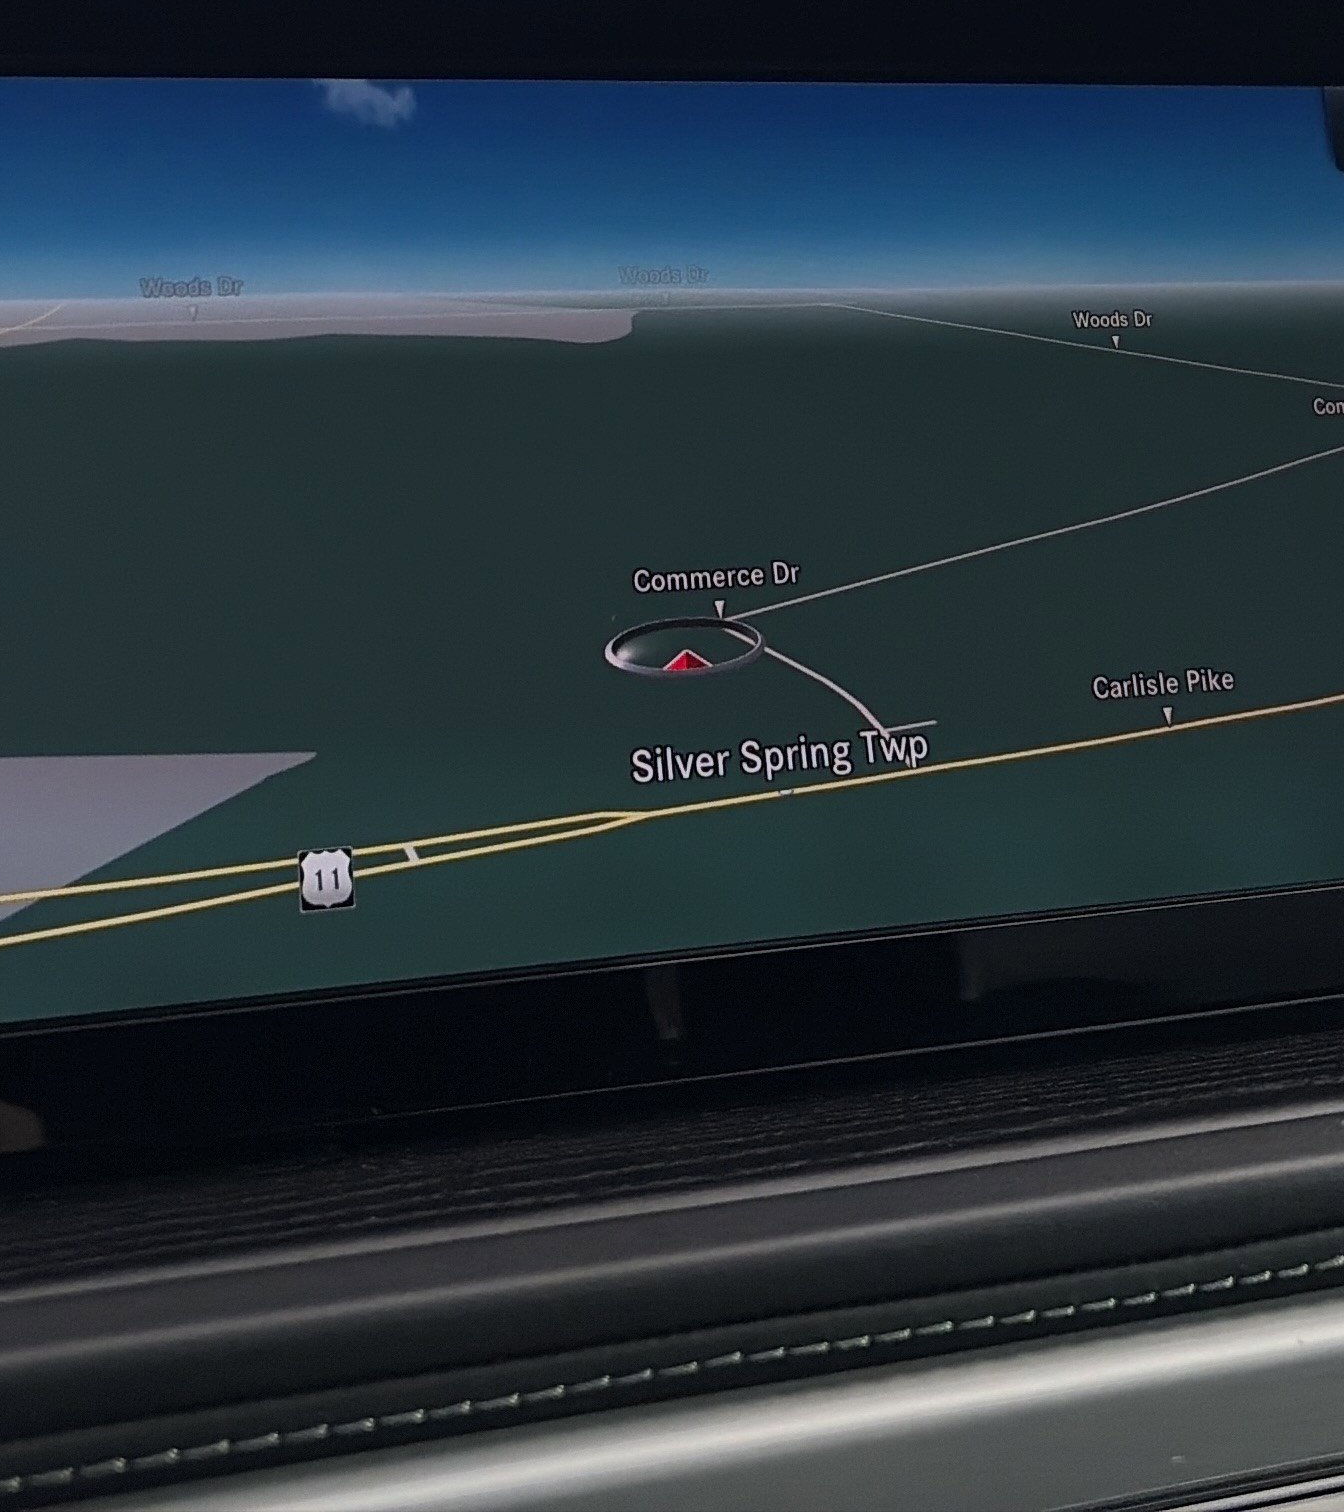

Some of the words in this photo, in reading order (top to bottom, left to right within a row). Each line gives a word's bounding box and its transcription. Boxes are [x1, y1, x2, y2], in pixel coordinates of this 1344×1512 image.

[139, 277, 212, 298] Woods
[217, 276, 244, 297] Dr
[1072, 311, 1129, 328] Woods
[1134, 310, 1152, 327] Dr
[633, 568, 764, 593] Commerce
[772, 561, 800, 585] Dr
[1092, 672, 1179, 700] Carlisle
[1186, 668, 1235, 693] Pike
[631, 746, 730, 783] Silver
[740, 735, 852, 781] Spring
[859, 730, 928, 768] Twp
[315, 867, 340, 892] 11
